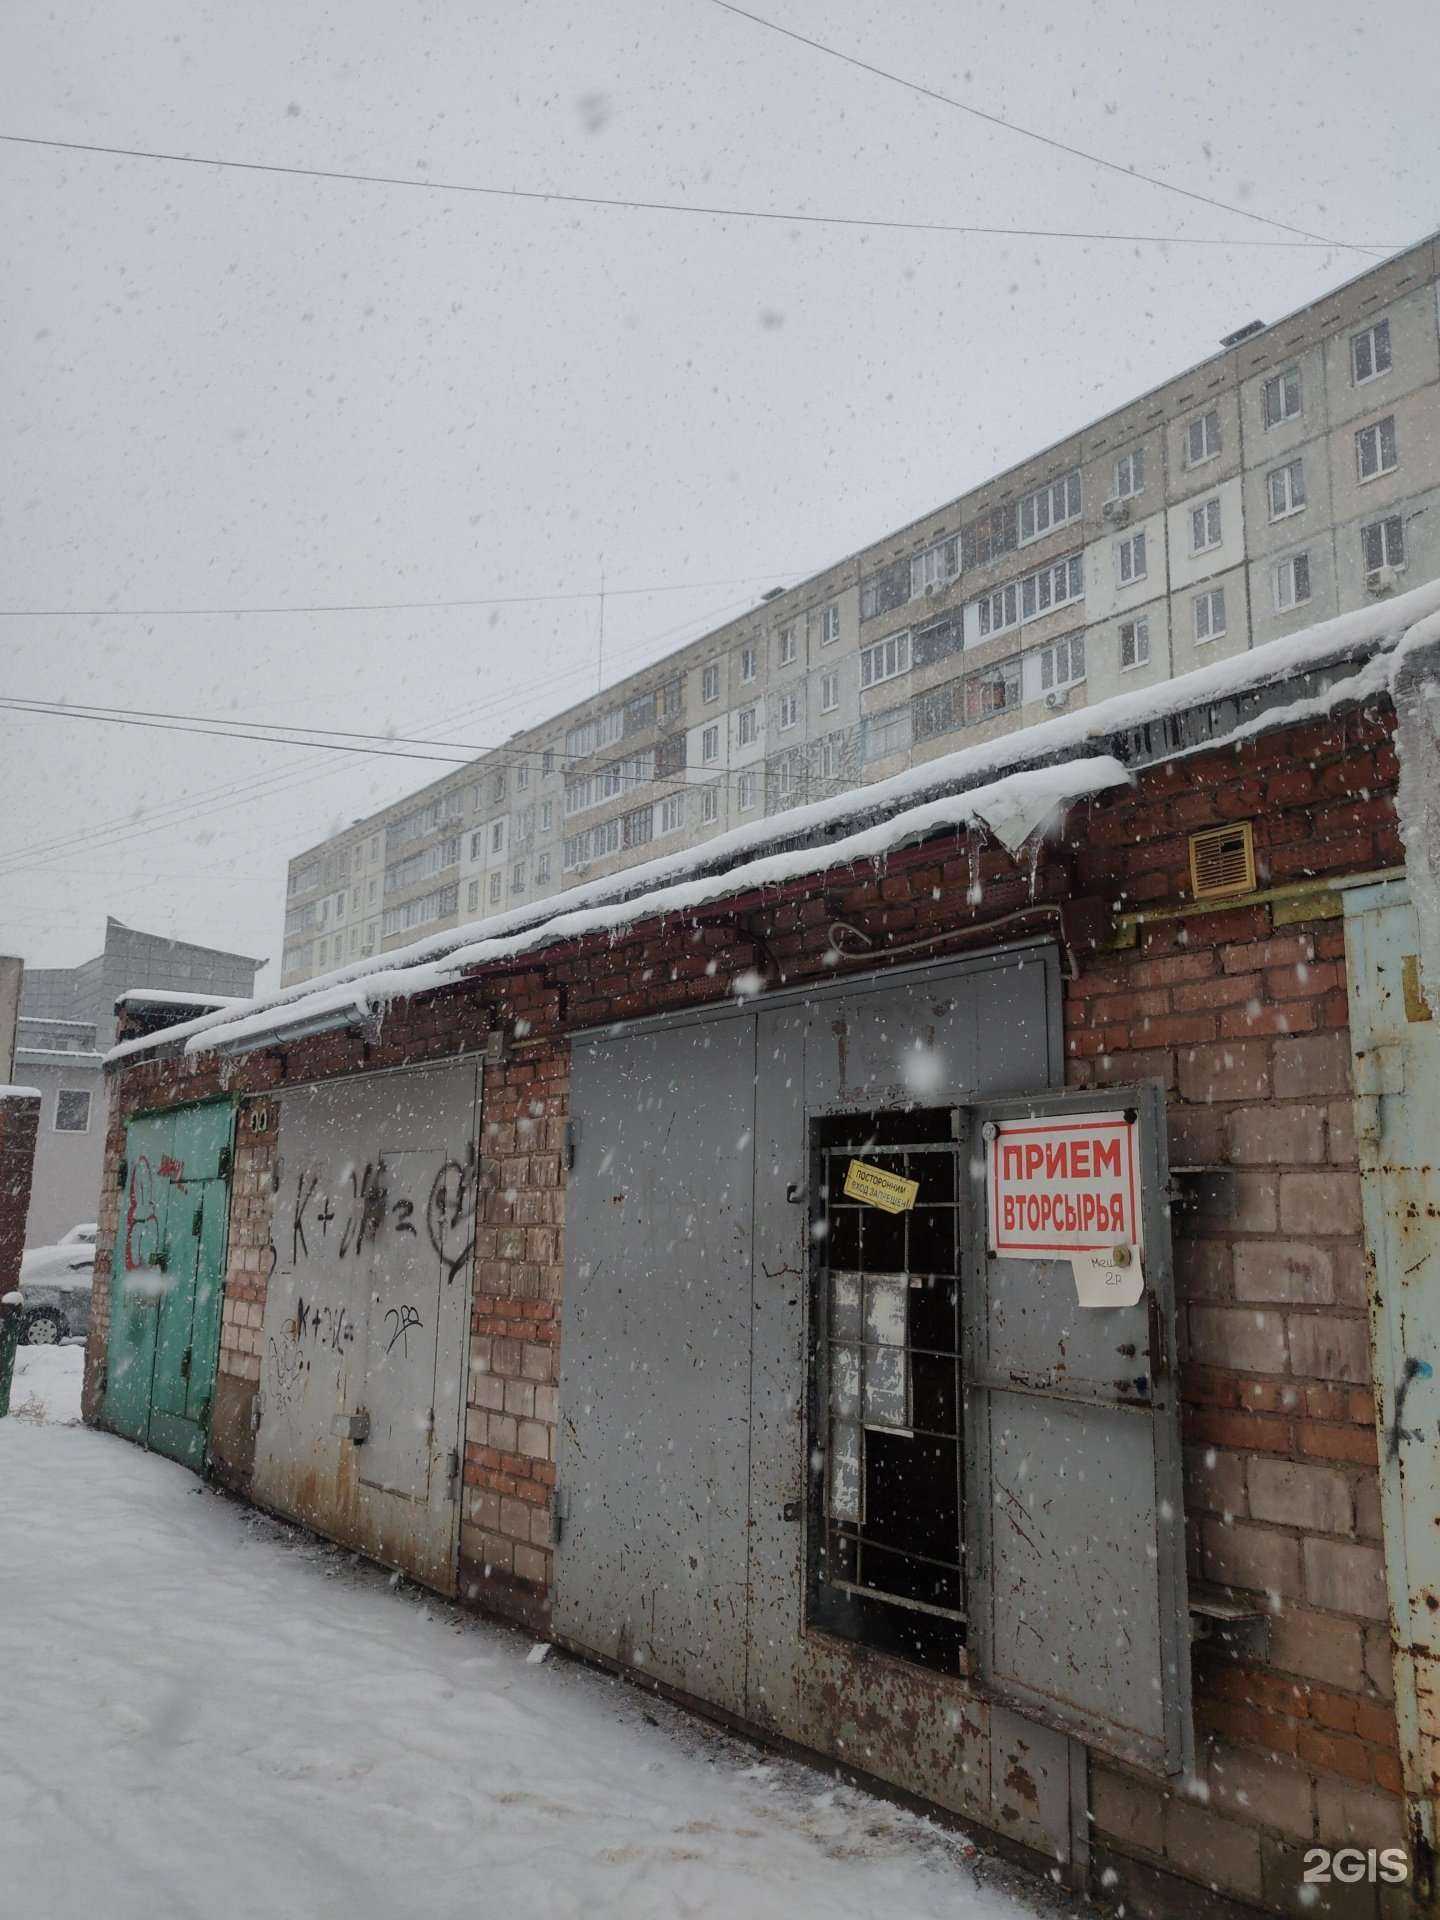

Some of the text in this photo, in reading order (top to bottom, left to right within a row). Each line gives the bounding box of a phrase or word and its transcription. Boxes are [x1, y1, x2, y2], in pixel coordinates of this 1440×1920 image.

[1003, 1139, 1121, 1180] ПРИЕМ
[855, 1169, 906, 1193] ПОСТОРОННИМ
[1003, 1193, 1125, 1232] ВТОРСЫРЬЯ
